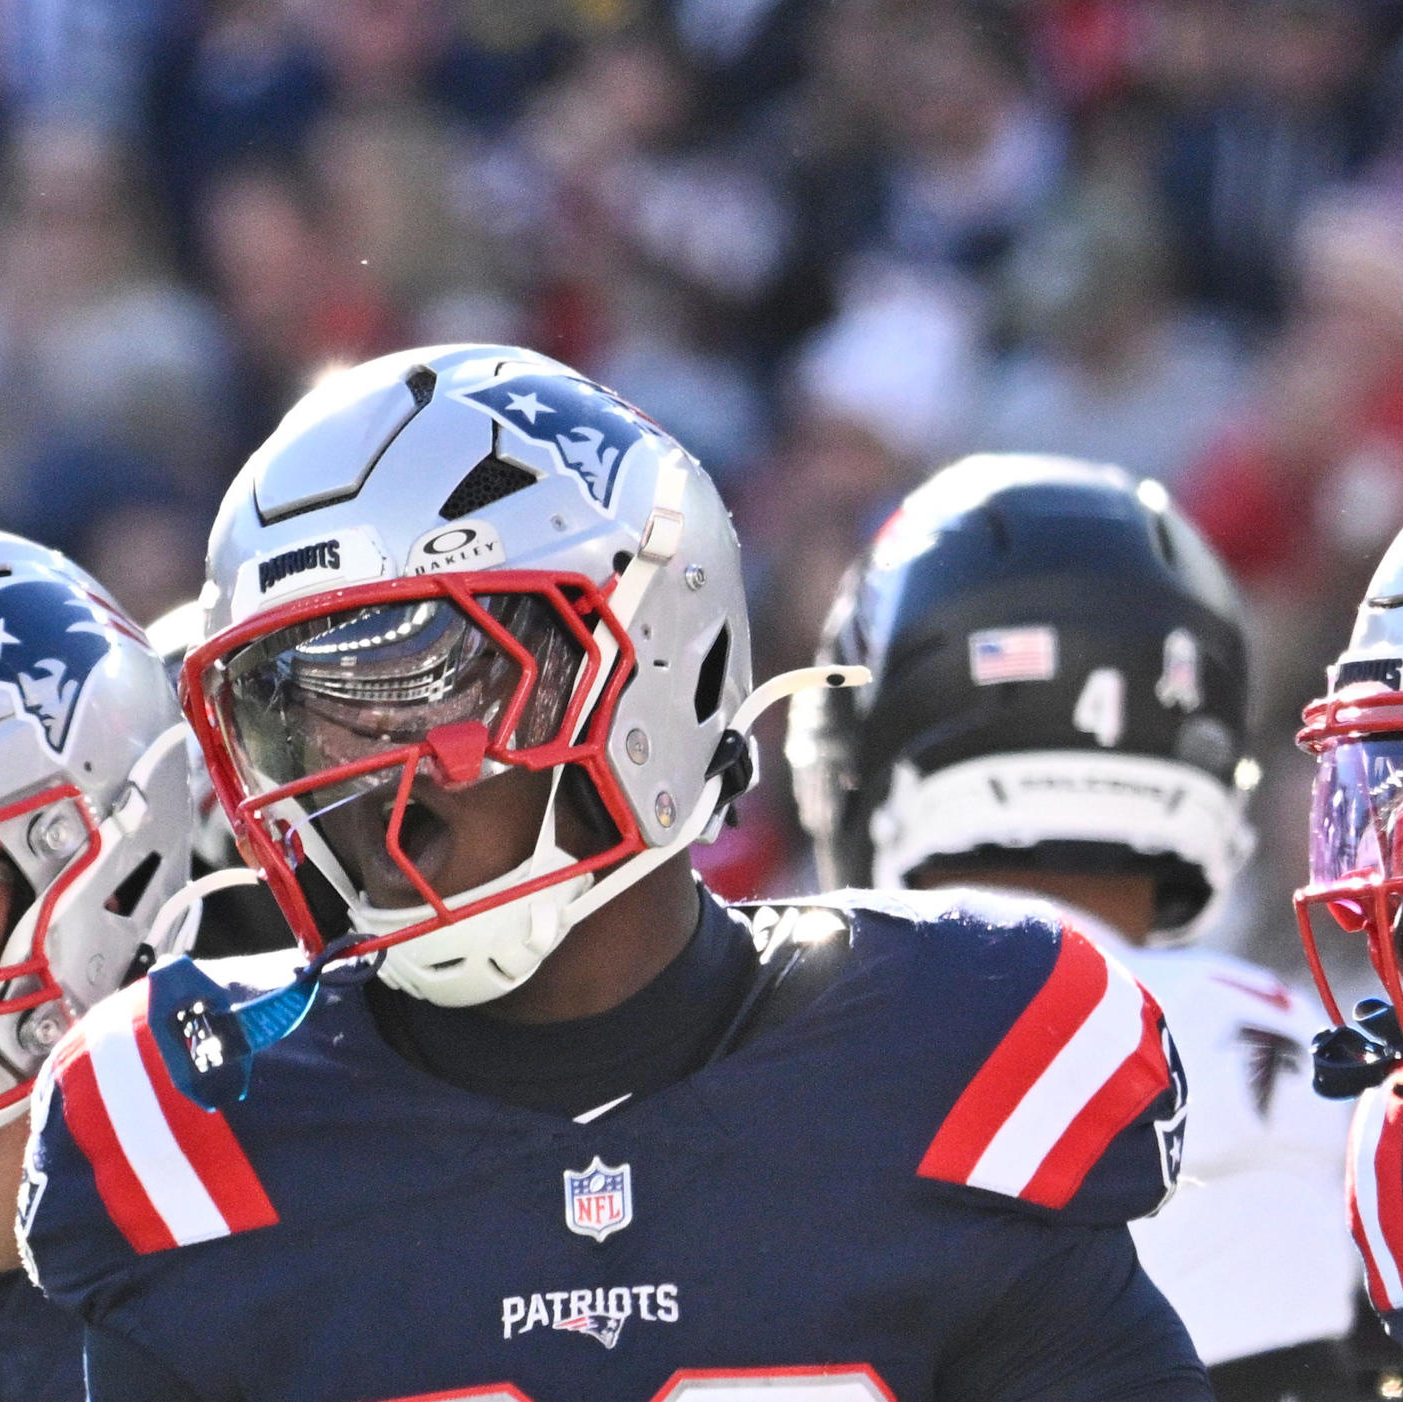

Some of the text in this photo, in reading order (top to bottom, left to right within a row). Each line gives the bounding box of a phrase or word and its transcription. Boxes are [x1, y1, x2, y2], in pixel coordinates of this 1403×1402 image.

[258, 538, 341, 594] PATRIOTS
[576, 1194, 621, 1224] NFL
[501, 1283, 680, 1340] PATRIOTS
